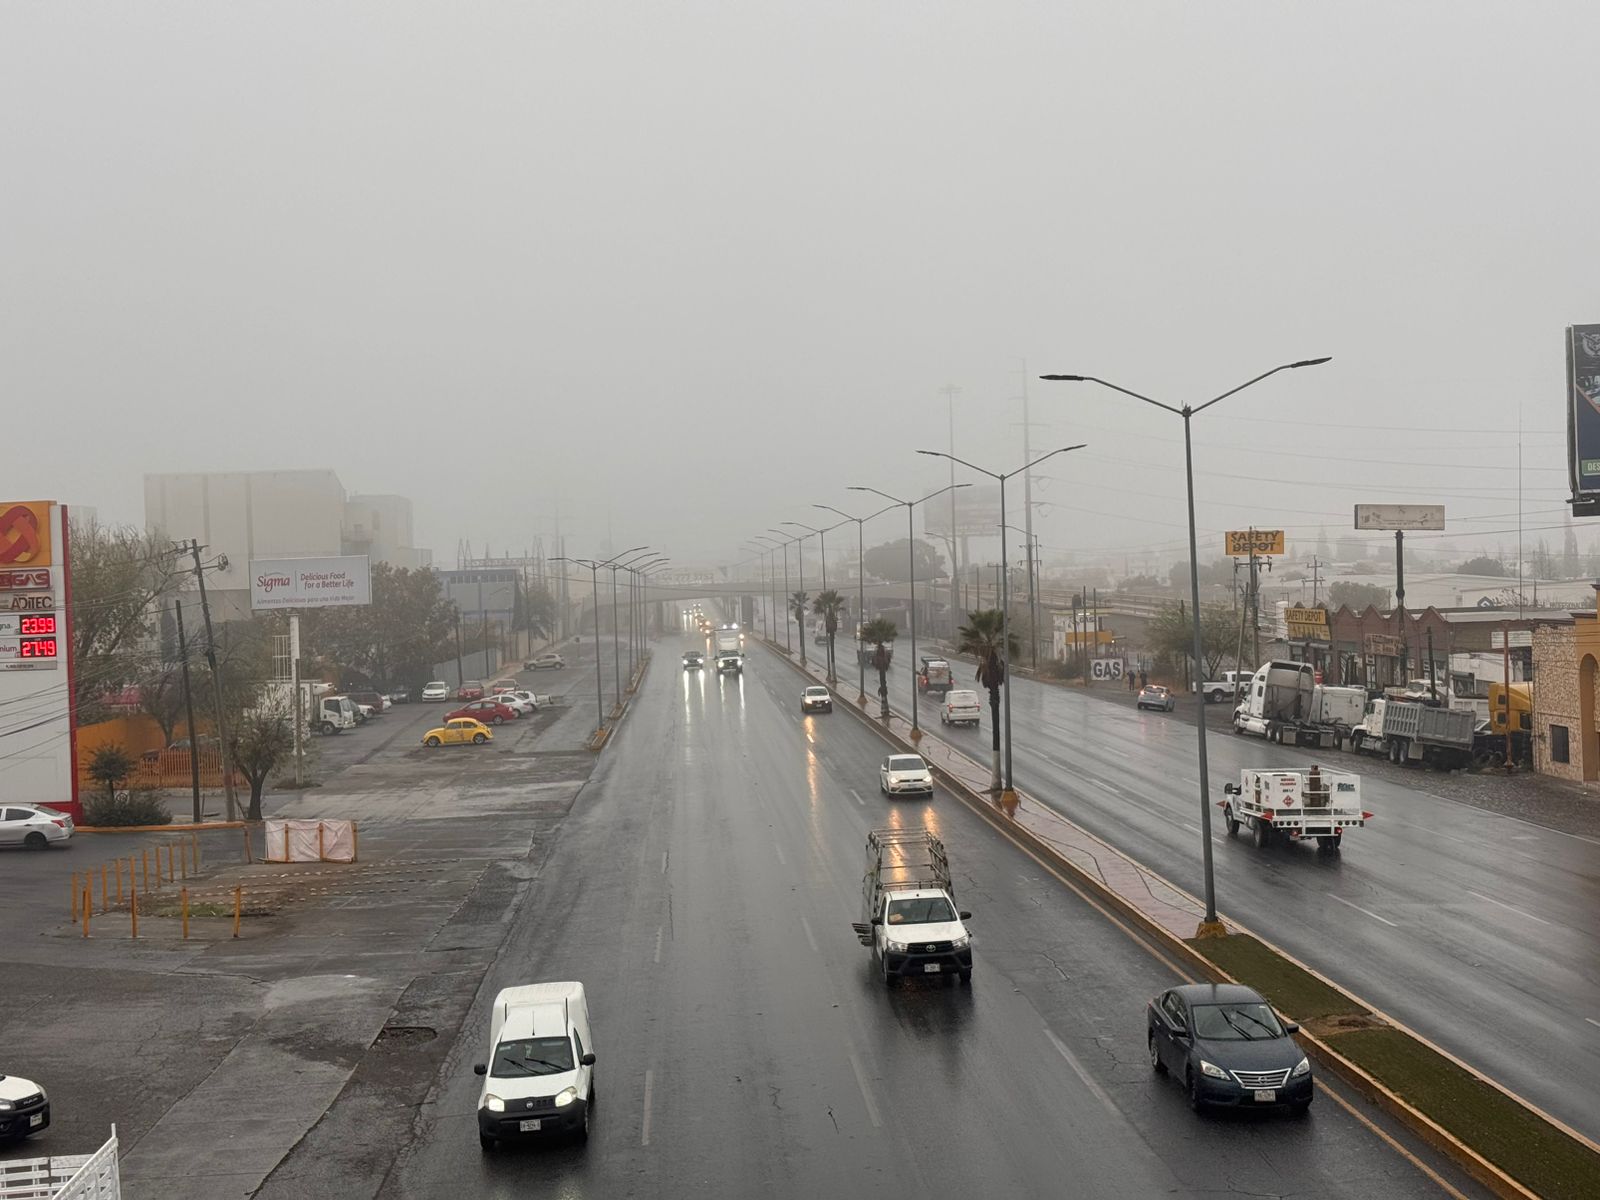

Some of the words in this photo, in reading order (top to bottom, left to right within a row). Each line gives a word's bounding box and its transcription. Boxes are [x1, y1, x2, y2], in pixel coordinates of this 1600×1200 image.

[1231, 530, 1279, 543] SAFETY
[1232, 542, 1276, 552] DEPOT
[300, 573, 329, 581] Delicious
[330, 571, 346, 580] Food
[257, 575, 290, 592] Sigma
[304, 581, 315, 590] for
[342, 579, 354, 588] Life
[1093, 662, 1121, 677] GAS
